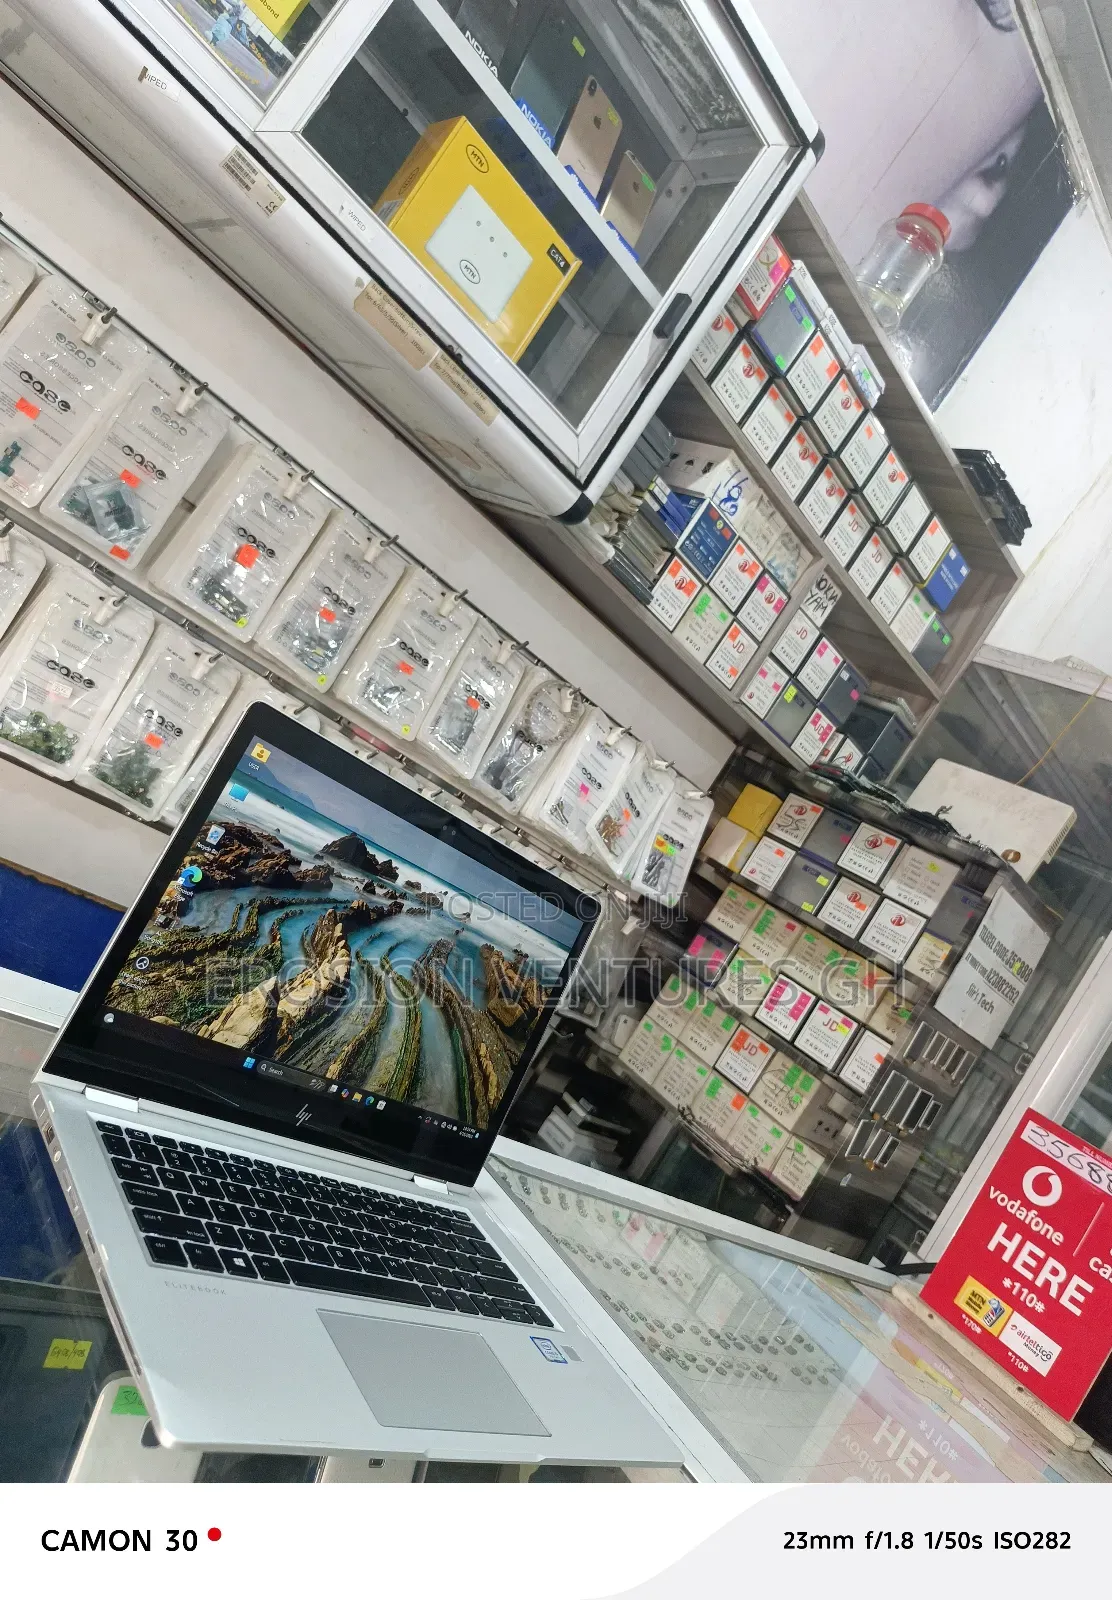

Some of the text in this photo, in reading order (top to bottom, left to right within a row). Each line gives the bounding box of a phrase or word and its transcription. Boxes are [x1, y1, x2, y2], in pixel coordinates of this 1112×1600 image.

[464, 30, 499, 78] NOKIA
[520, 103, 552, 147] NOKIA
[469, 151, 485, 168] MTN
[347, 209, 367, 232] WIPED
[549, 249, 566, 269] CAT4
[463, 263, 478, 281] MTN
[19, 370, 71, 412] case
[121, 445, 167, 481] case
[237, 527, 276, 559] case
[871, 551, 882, 564] JD
[323, 586, 356, 616] case
[796, 627, 808, 640] JD
[399, 641, 430, 667] case
[733, 640, 745, 654] JD
[46, 659, 96, 689] case
[464, 684, 491, 710] case
[145, 709, 184, 738] case
[248, 762, 260, 771] USER
[581, 767, 602, 790] case
[624, 792, 641, 818] case
[663, 833, 685, 850] case
[977, 992, 995, 1015] Tech
[822, 1017, 839, 1033] JD
[743, 1042, 759, 1057] JD
[268, 1066, 283, 1077] Search
[989, 1185, 1064, 1246] vodafone
[987, 1221, 1094, 1317] HERE
[164, 1280, 226, 1295] ELITEBOOK
[970, 1289, 987, 1306] MTN
[1023, 1341, 1040, 1357] Money
